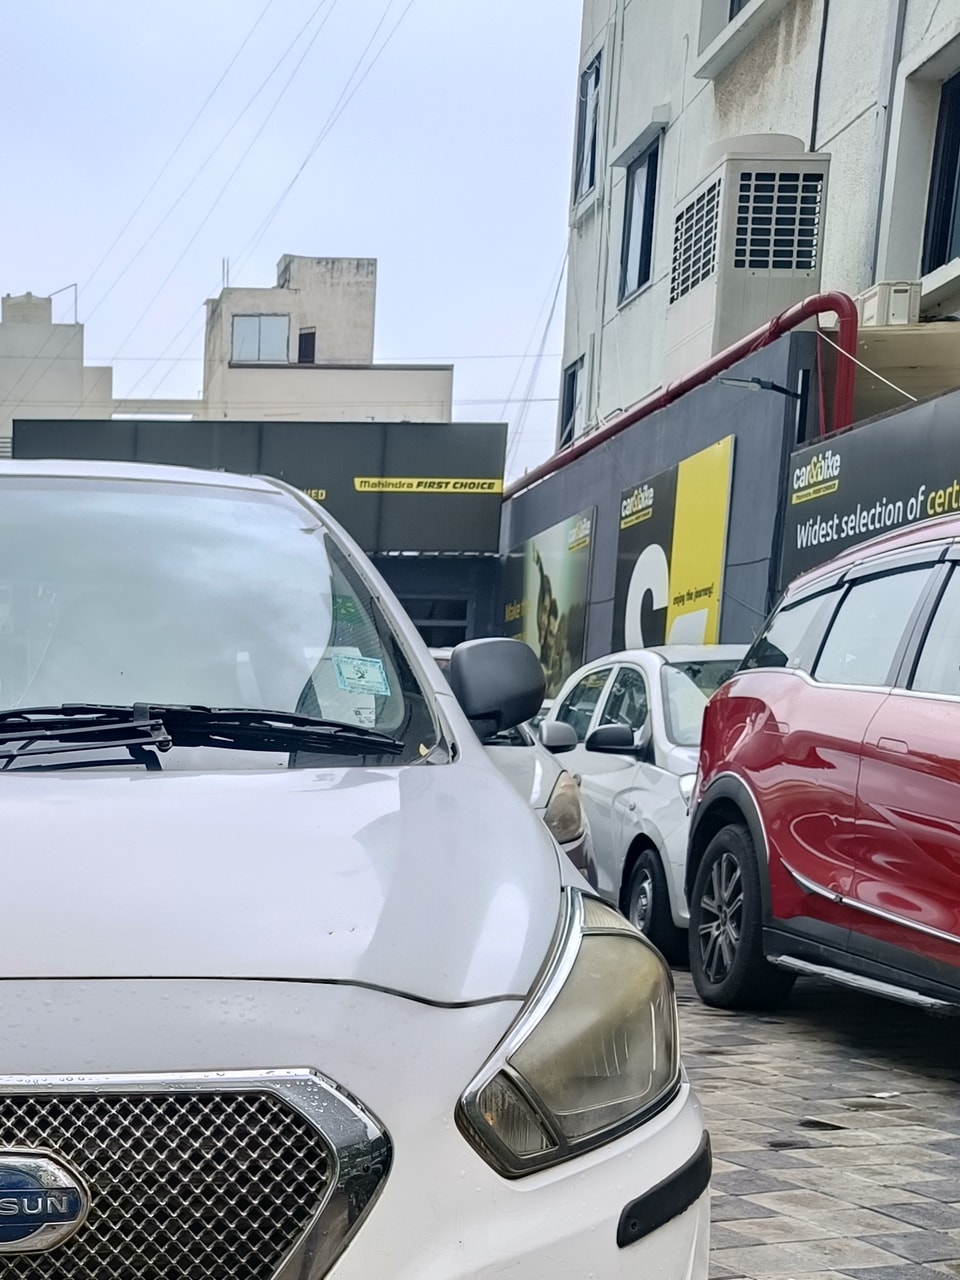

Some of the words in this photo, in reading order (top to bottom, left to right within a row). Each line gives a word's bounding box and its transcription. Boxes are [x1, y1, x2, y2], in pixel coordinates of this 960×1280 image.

[359, 480, 413, 489] Mahindra
[415, 481, 451, 490] FIRST
[452, 481, 495, 490] CHOICE
[793, 450, 840, 490] car&bike
[797, 513, 839, 549] Widest
[841, 497, 903, 539] selection
[906, 485, 926, 521] of
